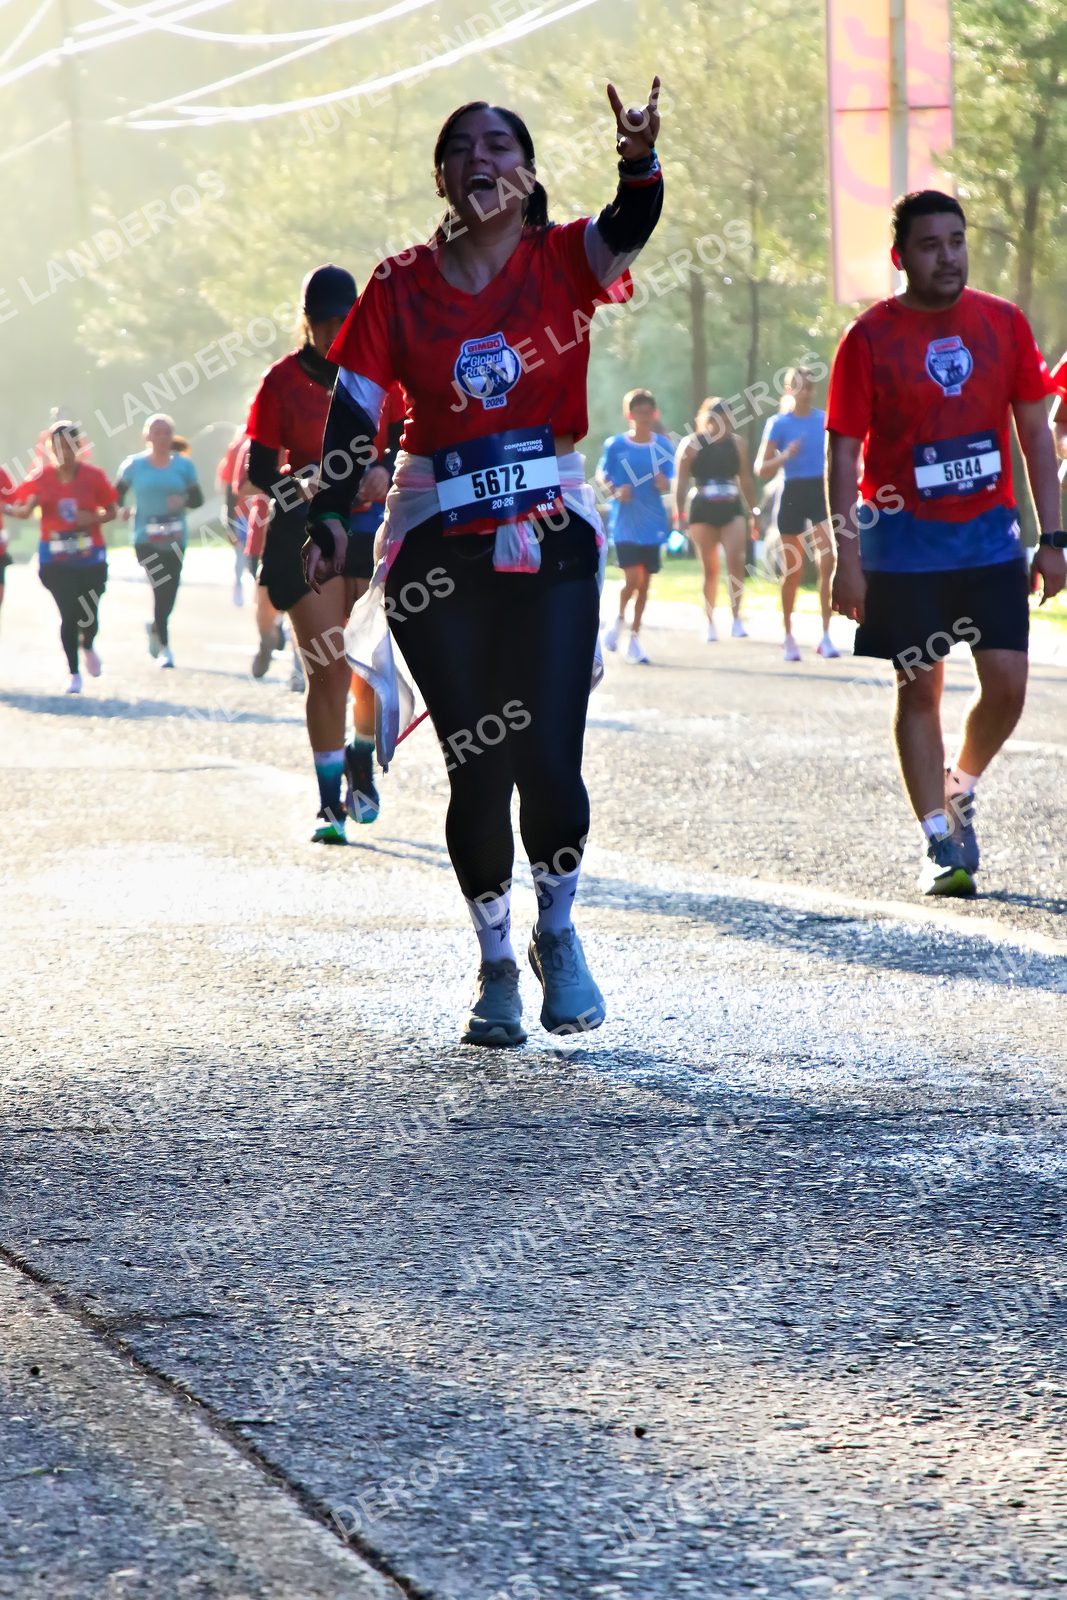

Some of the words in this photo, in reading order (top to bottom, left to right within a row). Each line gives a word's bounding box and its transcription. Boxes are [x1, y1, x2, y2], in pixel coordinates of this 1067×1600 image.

[467, 339, 501, 353] BIMBO
[470, 351, 503, 367] Global
[465, 364, 492, 378] Race
[485, 396, 505, 408] 2026
[943, 457, 982, 482] 5644
[471, 464, 527, 499] 5672
[536, 502, 554, 511] 10K
